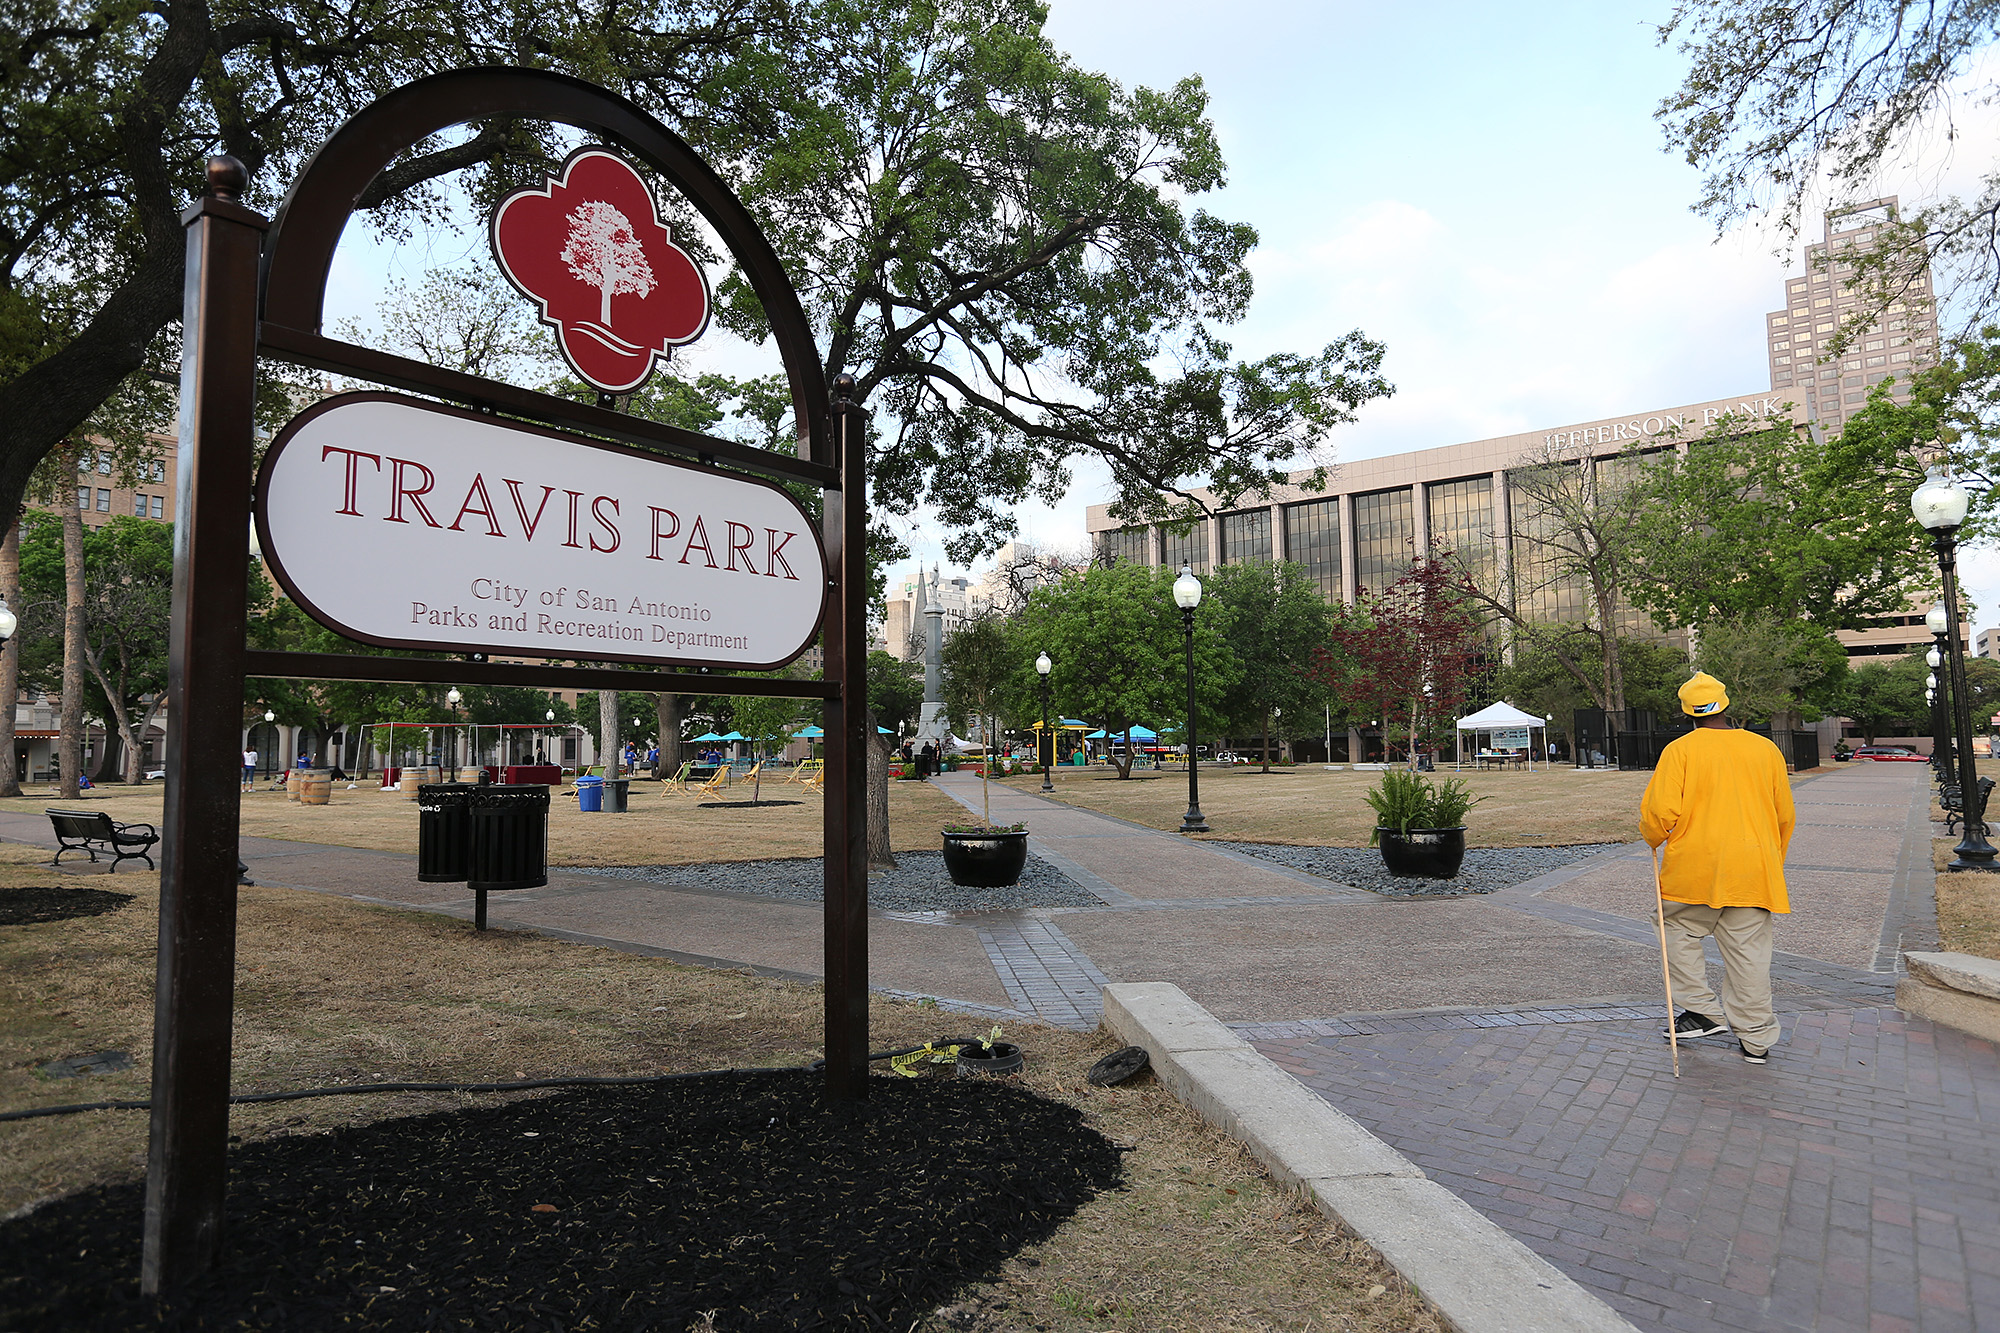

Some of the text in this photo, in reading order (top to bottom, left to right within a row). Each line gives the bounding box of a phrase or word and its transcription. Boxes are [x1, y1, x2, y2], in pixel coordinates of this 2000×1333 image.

[1544, 396, 1781, 454] JEFFERSON BANK
[321, 445, 799, 581] TRAVIS PARK
[410, 602, 748, 650] Parks and Recreation Department
[471, 578, 712, 622] City of San Antonio
